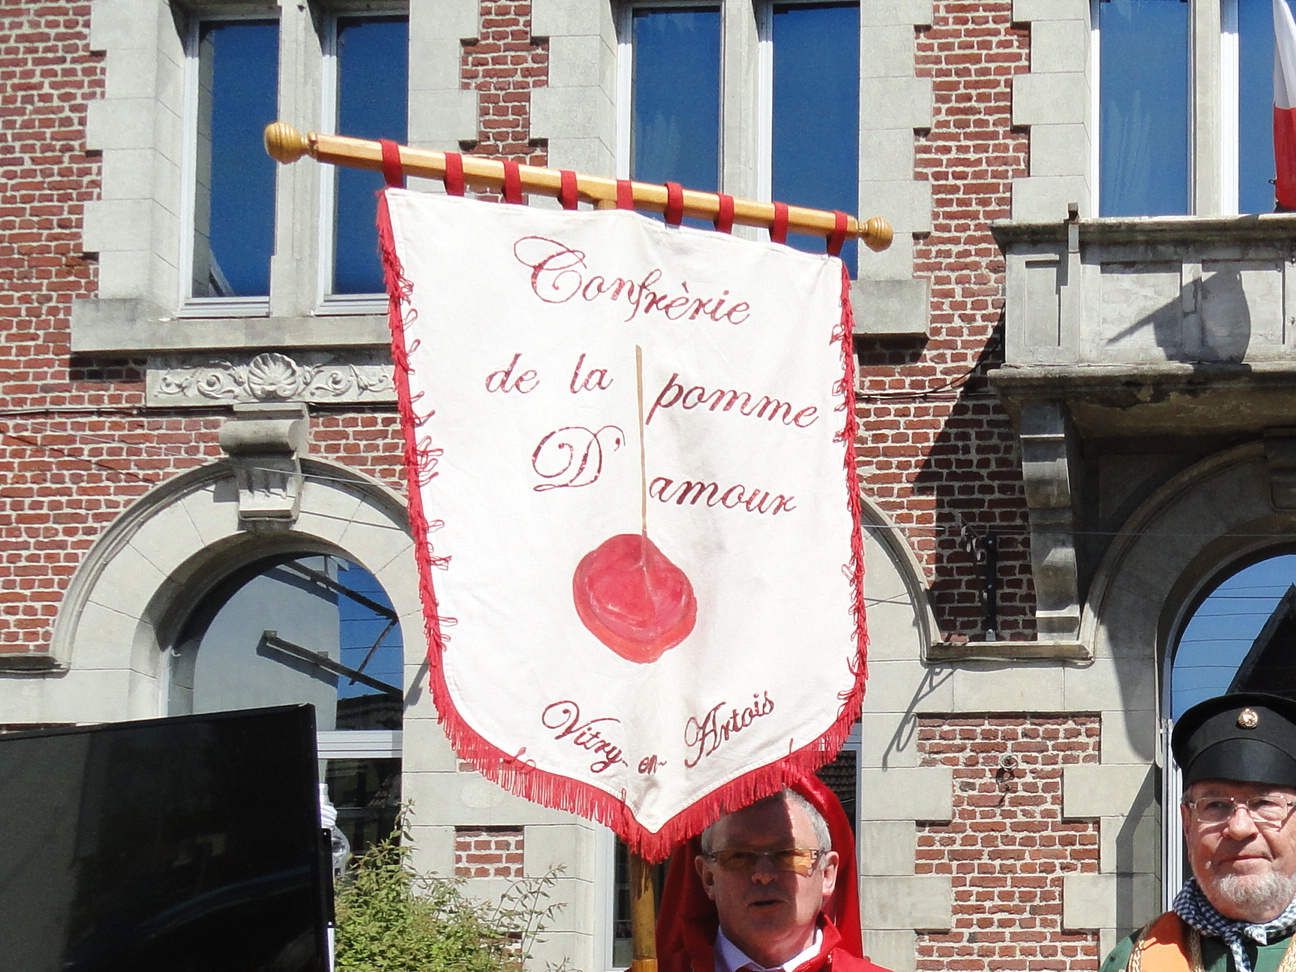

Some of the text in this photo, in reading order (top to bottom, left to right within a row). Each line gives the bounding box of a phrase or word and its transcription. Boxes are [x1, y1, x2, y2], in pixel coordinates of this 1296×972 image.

[513, 236, 751, 325] Confrèrie
[485, 353, 820, 428] de la pomme
[649, 476, 798, 516] amour
[684, 690, 775, 768] Artois
